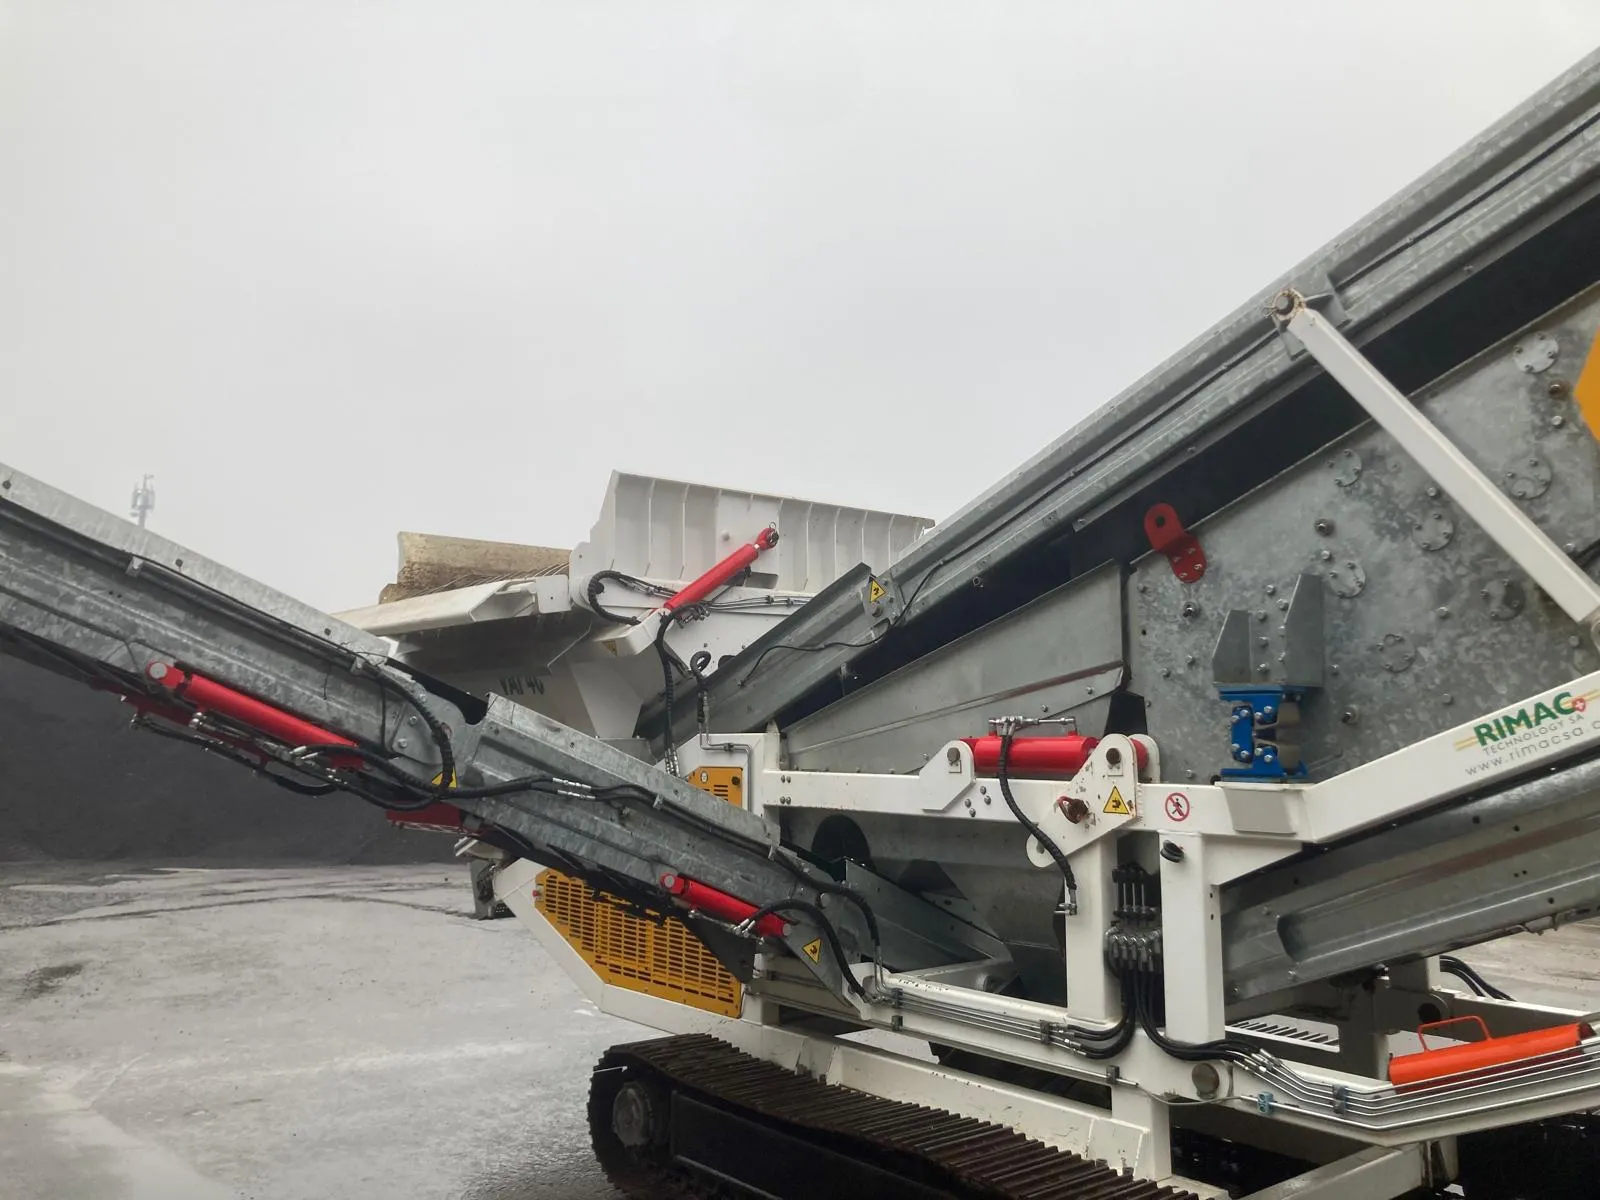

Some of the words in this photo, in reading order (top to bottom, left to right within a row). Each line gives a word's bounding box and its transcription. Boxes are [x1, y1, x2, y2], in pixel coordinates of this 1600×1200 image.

[1473, 691, 1577, 746] RIMAC
[1482, 719, 1564, 756] TECHNOLOGY
[1568, 714, 1585, 724] SA
